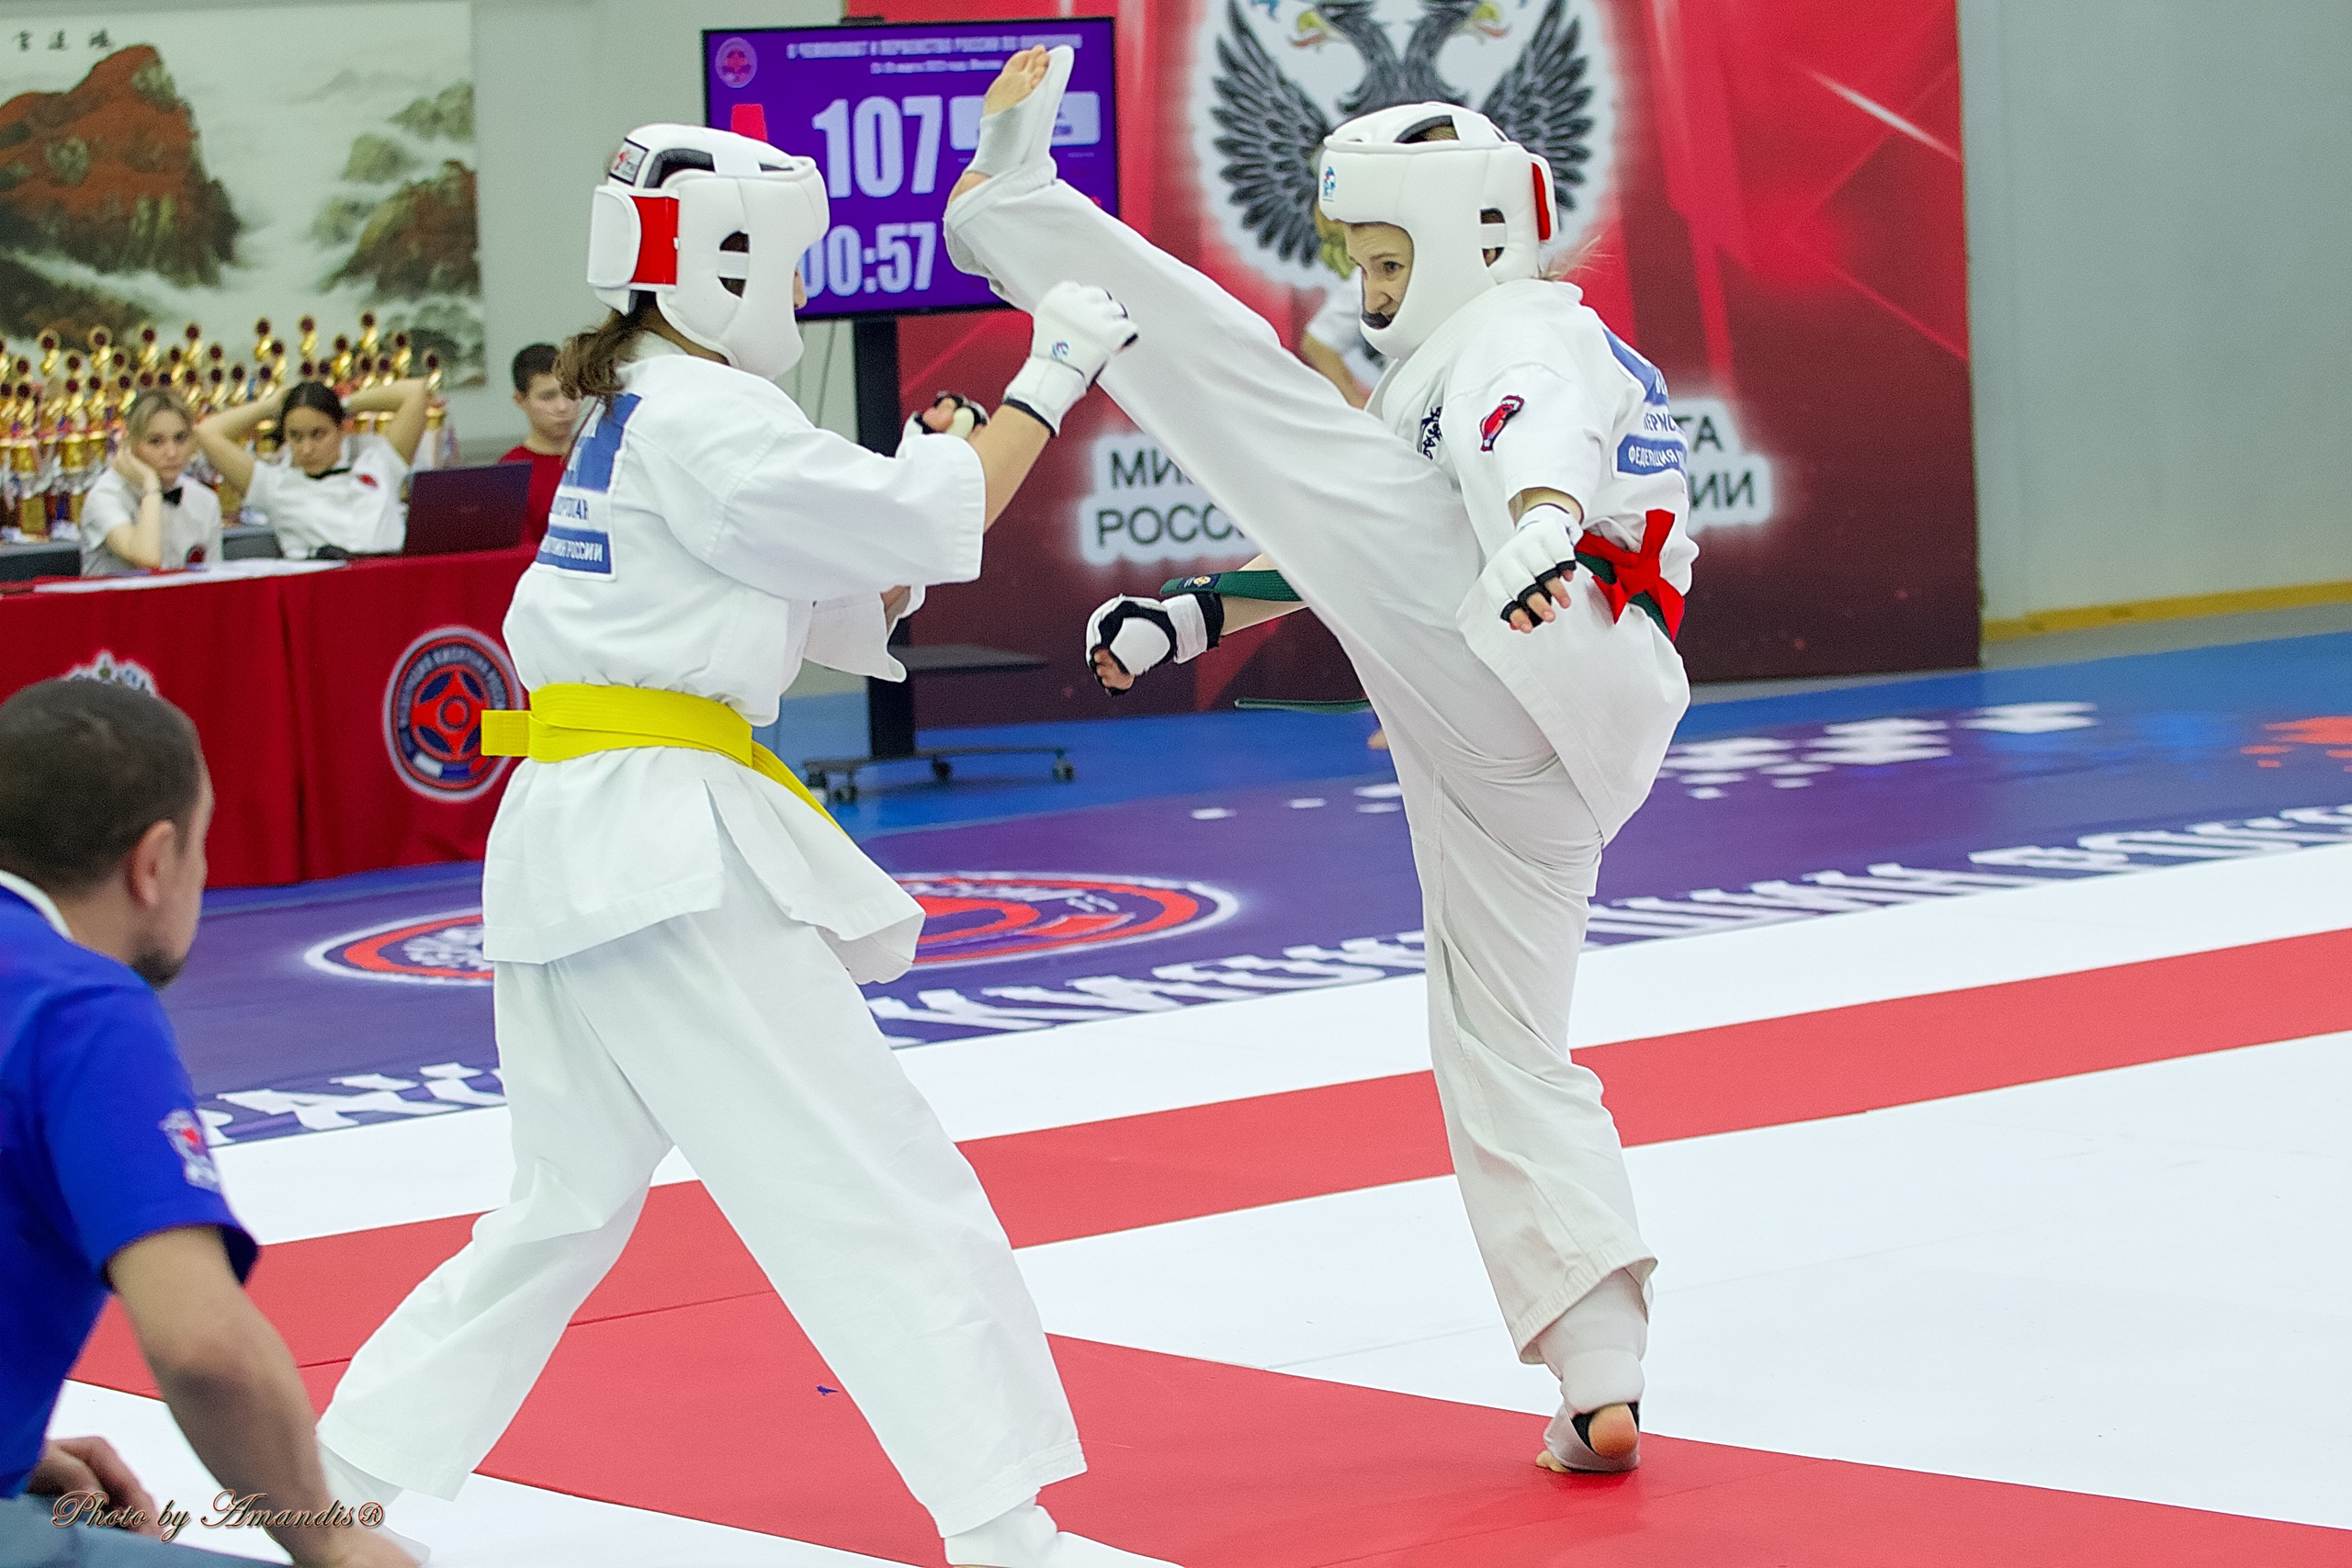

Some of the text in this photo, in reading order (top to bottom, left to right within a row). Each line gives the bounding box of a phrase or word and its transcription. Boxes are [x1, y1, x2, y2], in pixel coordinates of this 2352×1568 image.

[812, 95, 944, 198] 107
[797, 221, 937, 299] 00:57
[1096, 503, 1245, 547] РОСС
